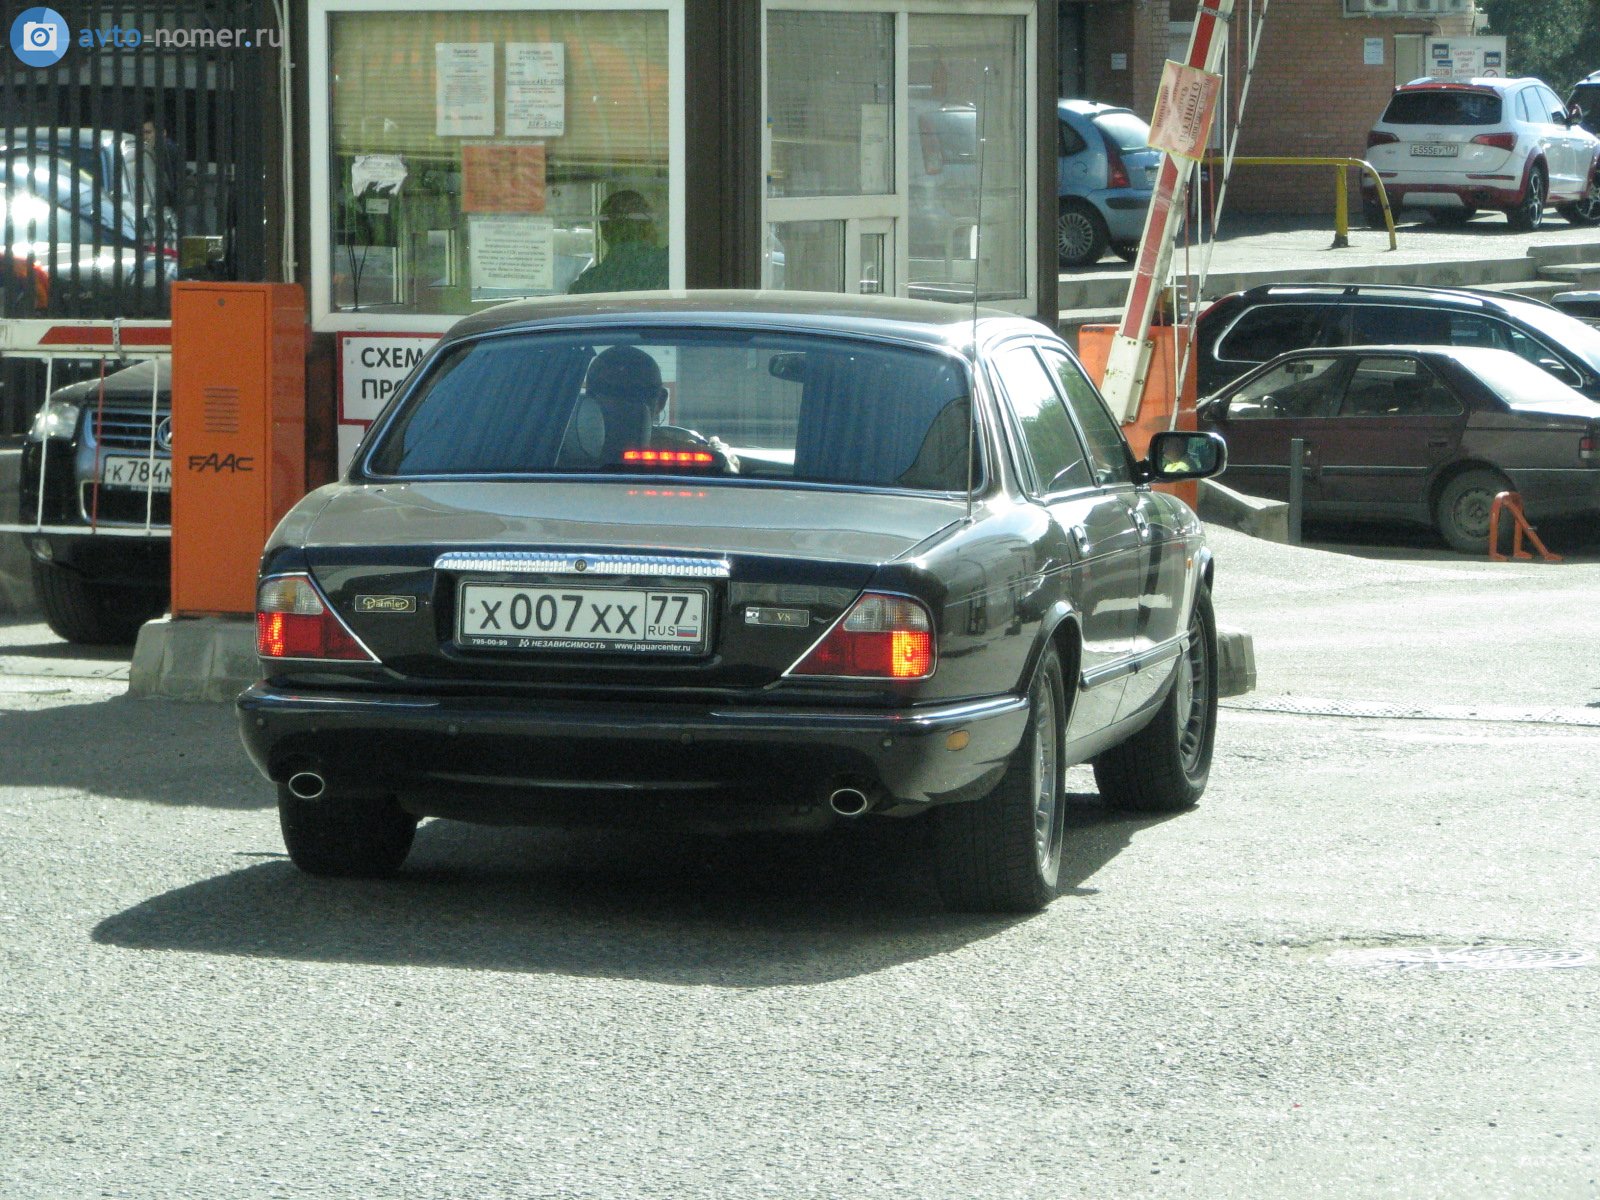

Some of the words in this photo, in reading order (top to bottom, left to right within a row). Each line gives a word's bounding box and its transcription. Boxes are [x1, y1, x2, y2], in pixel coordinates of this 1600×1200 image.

[188, 453, 254, 473] FAAC
[362, 597, 409, 610] Daimler
[480, 593, 637, 634] Х007ХХ
[651, 595, 689, 625] 77
[776, 612, 791, 622] V8
[647, 625, 675, 636] RUS
[472, 638, 508, 646] 795-00-99
[531, 640, 606, 650] НЕЗАВИСИМОСТЬ
[614, 642, 691, 652] www.jaguarcenter.ru
